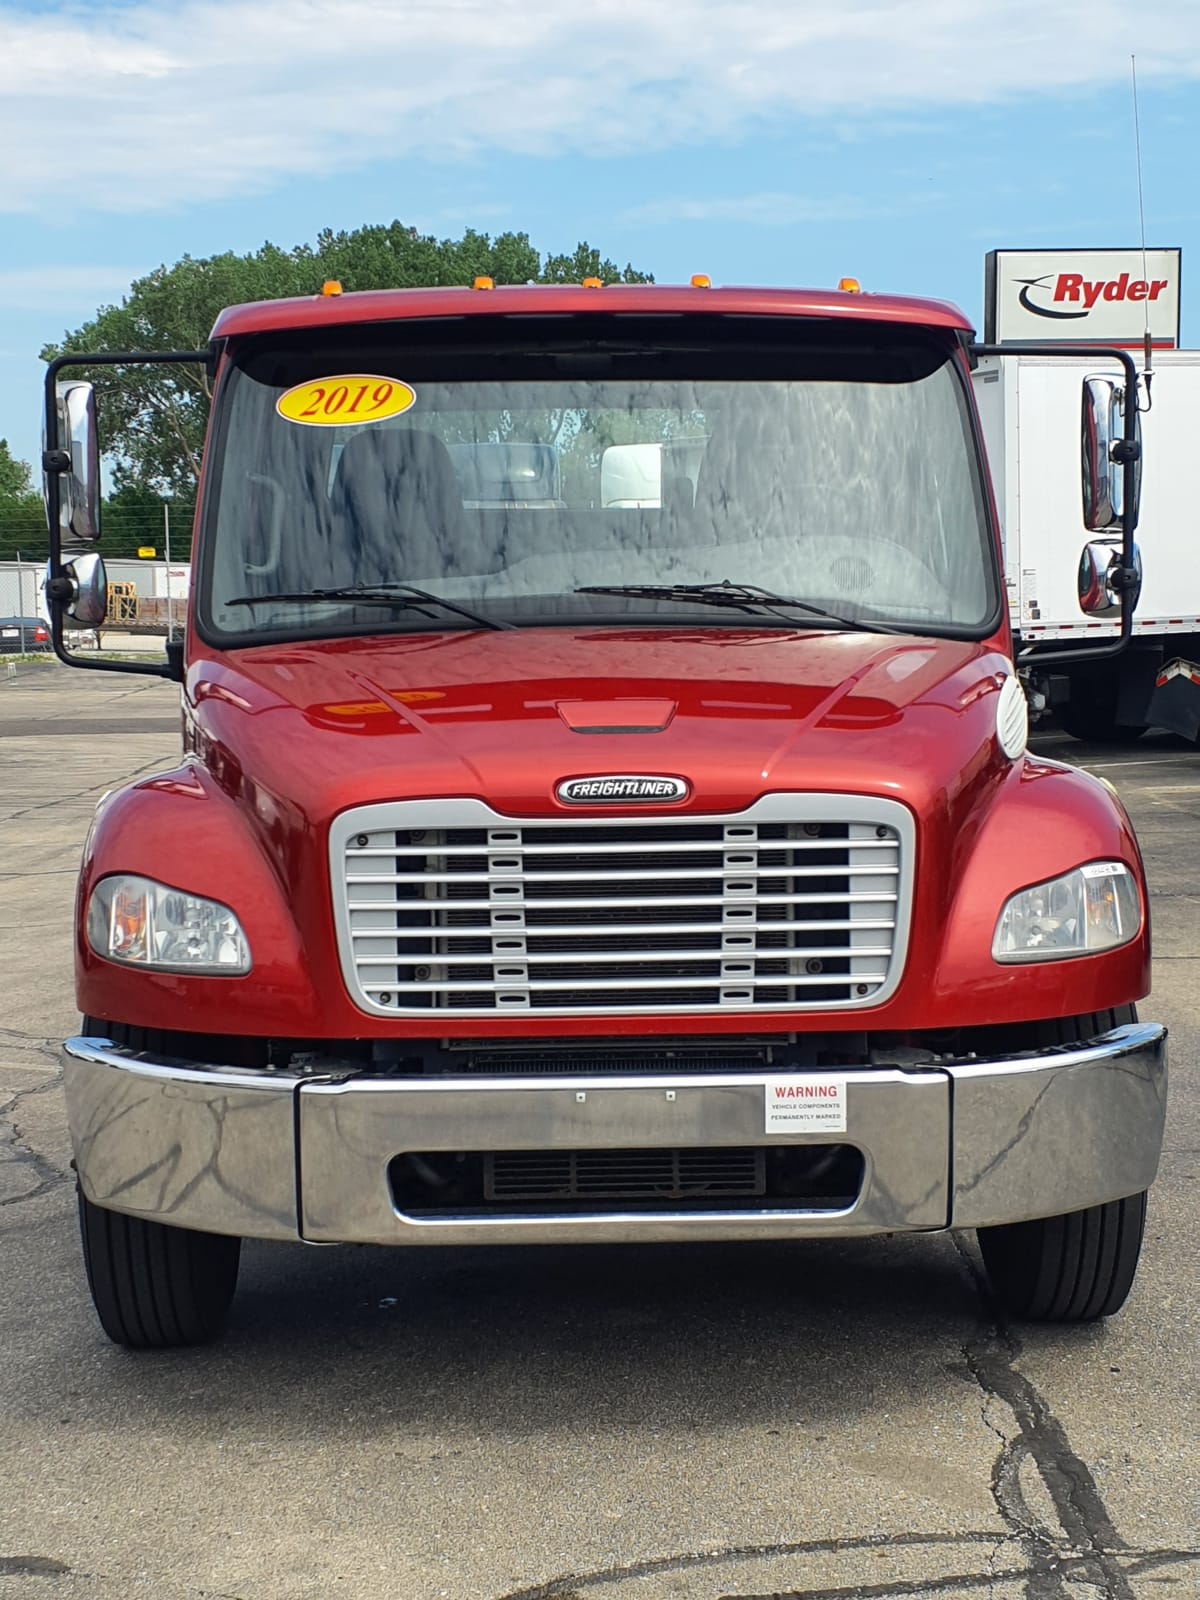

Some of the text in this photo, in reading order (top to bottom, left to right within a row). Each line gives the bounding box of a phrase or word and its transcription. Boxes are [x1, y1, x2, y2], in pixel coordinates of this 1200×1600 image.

[1053, 273, 1168, 308] Ryder
[299, 383, 393, 417] 2019
[571, 782, 674, 797] FREIGHTLINER
[775, 1086, 838, 1098] WARNING
